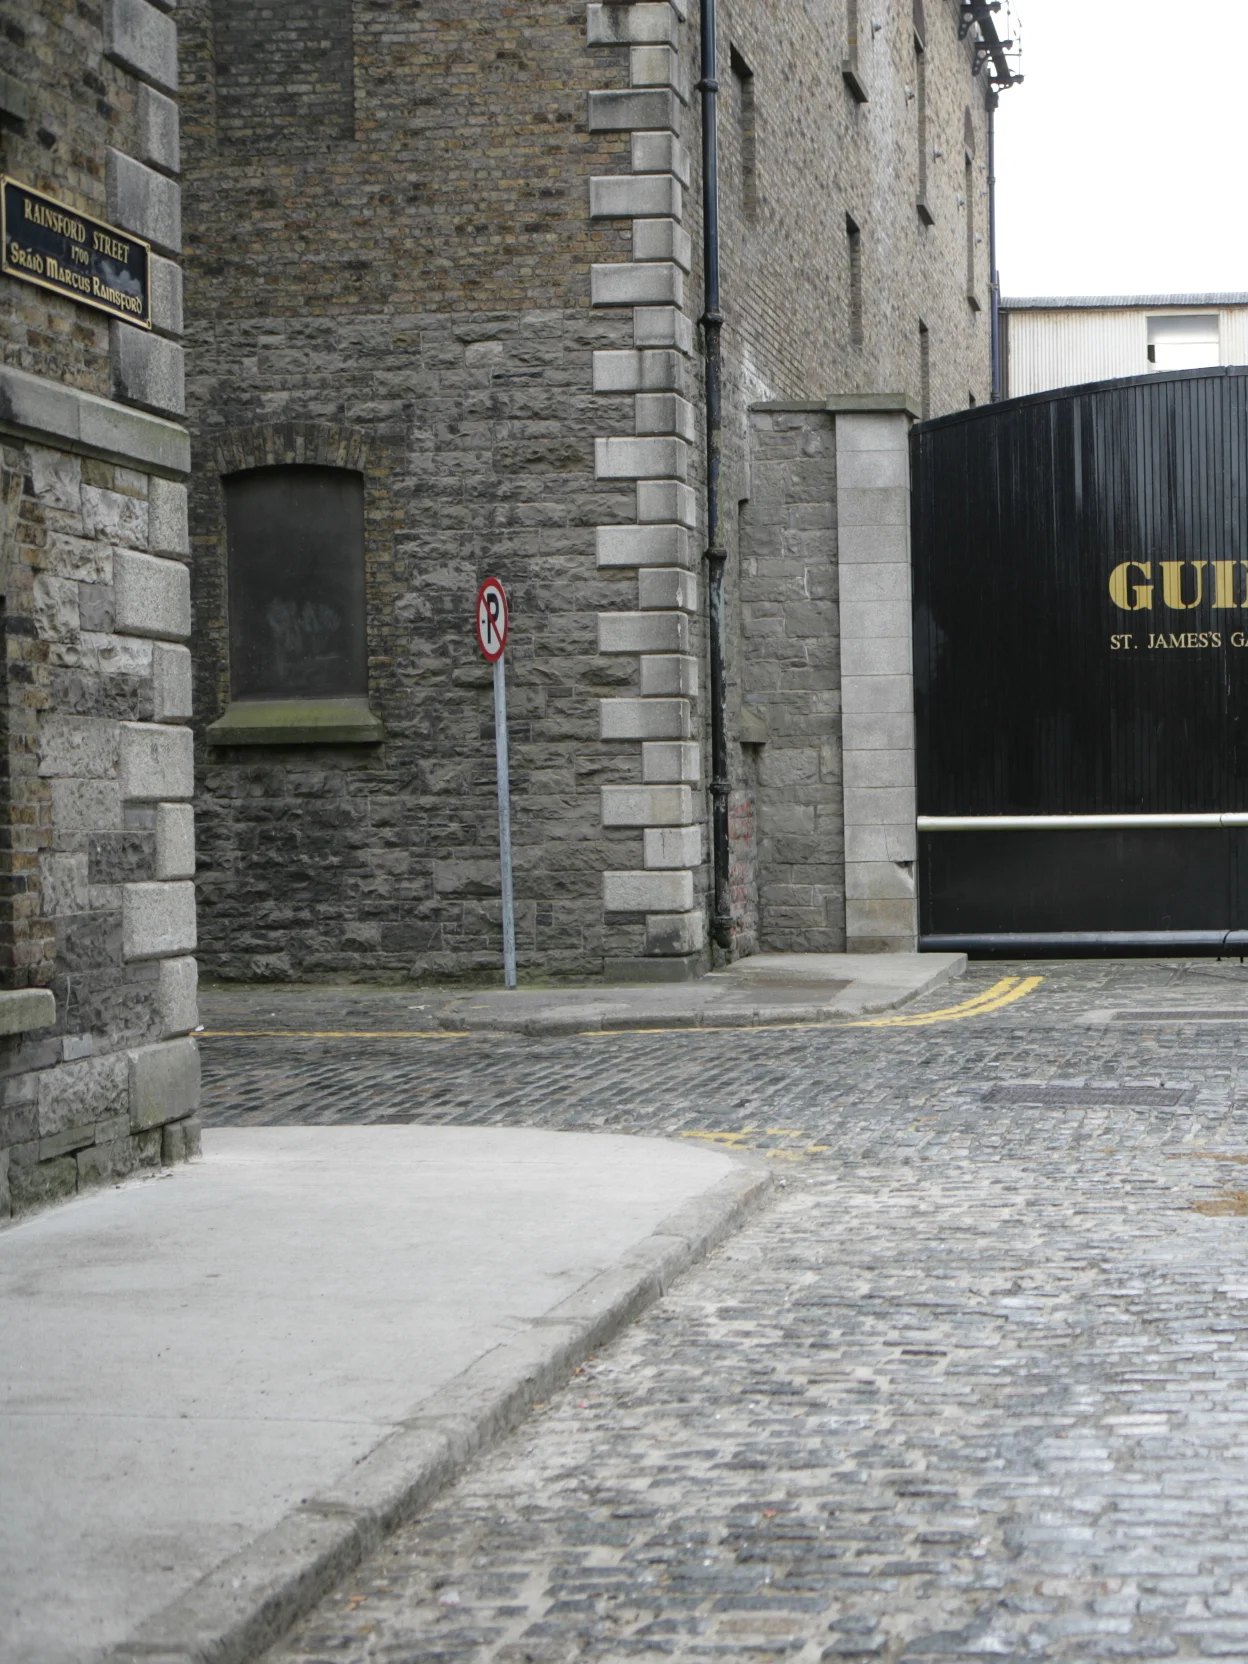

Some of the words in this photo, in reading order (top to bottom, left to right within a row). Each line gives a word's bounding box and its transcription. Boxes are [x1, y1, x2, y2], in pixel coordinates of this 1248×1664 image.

[24, 199, 86, 243] RAINSFORD
[93, 231, 129, 264] STREET
[71, 245, 89, 266] 1700
[486, 593, 499, 644] P
[1110, 634, 1138, 650] ST.
[1147, 631, 1222, 649] JAMES'S
